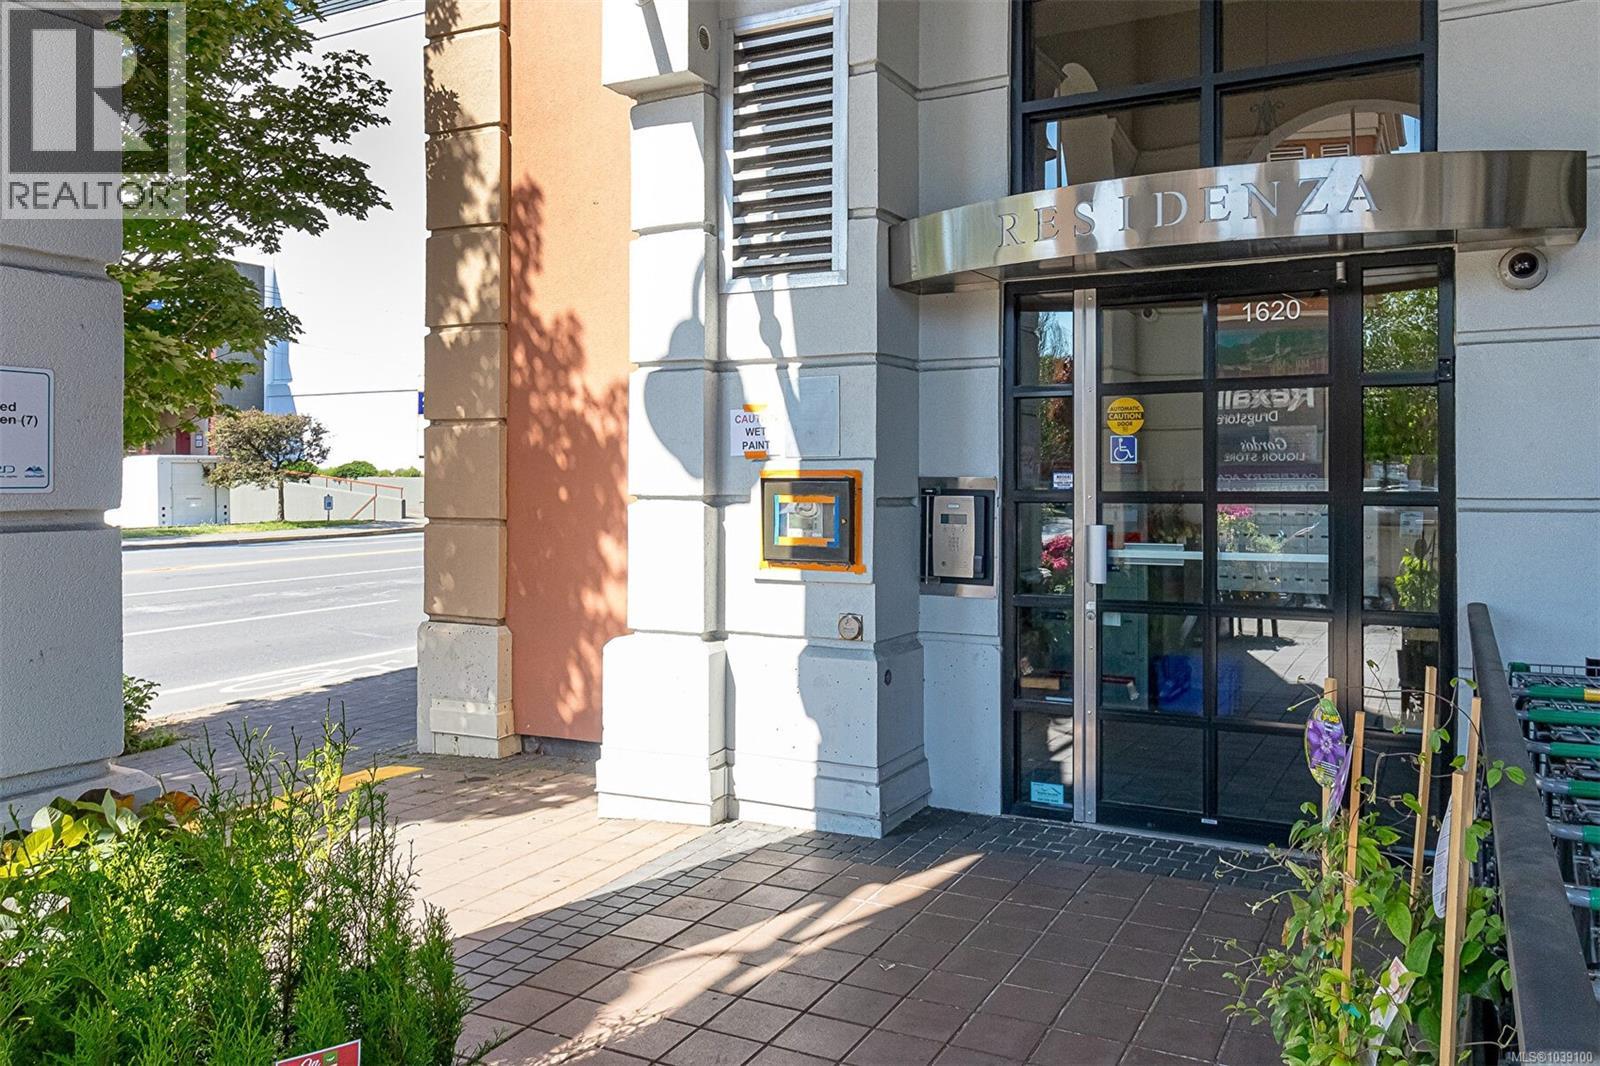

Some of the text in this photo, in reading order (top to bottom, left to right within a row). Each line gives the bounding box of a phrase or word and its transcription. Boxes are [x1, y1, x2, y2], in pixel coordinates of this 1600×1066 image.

[997, 174, 1382, 248] RESIDENZA
[1242, 299, 1301, 322] 1620
[21, 415, 38, 428] (7)
[1108, 412, 1142, 420] CAUTION
[745, 426, 766, 436] WET
[742, 440, 770, 450] PAINT
